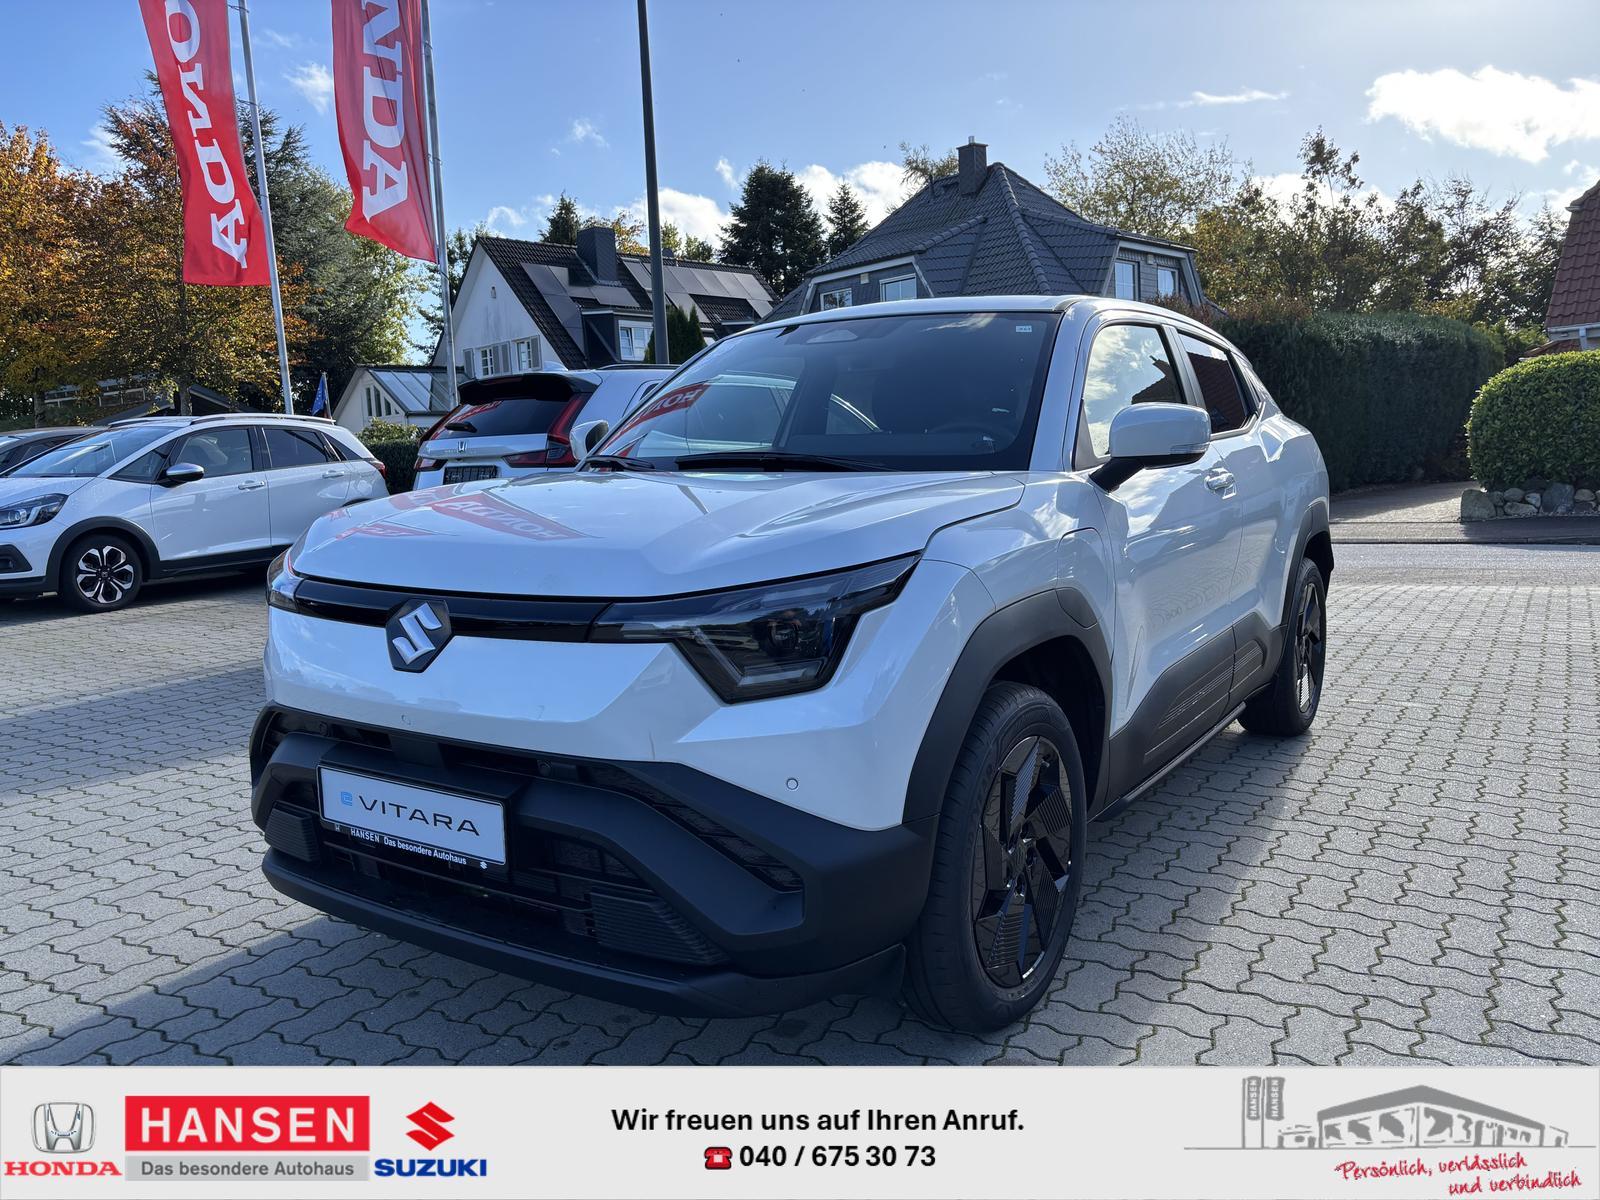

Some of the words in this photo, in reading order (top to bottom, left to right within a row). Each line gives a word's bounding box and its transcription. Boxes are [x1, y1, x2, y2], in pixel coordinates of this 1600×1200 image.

[358, 795, 480, 837] VITARA
[350, 827, 380, 842] HANSEN
[383, 836, 397, 847] Das
[397, 840, 432, 856] besondere
[433, 849, 467, 864] Autohaus
